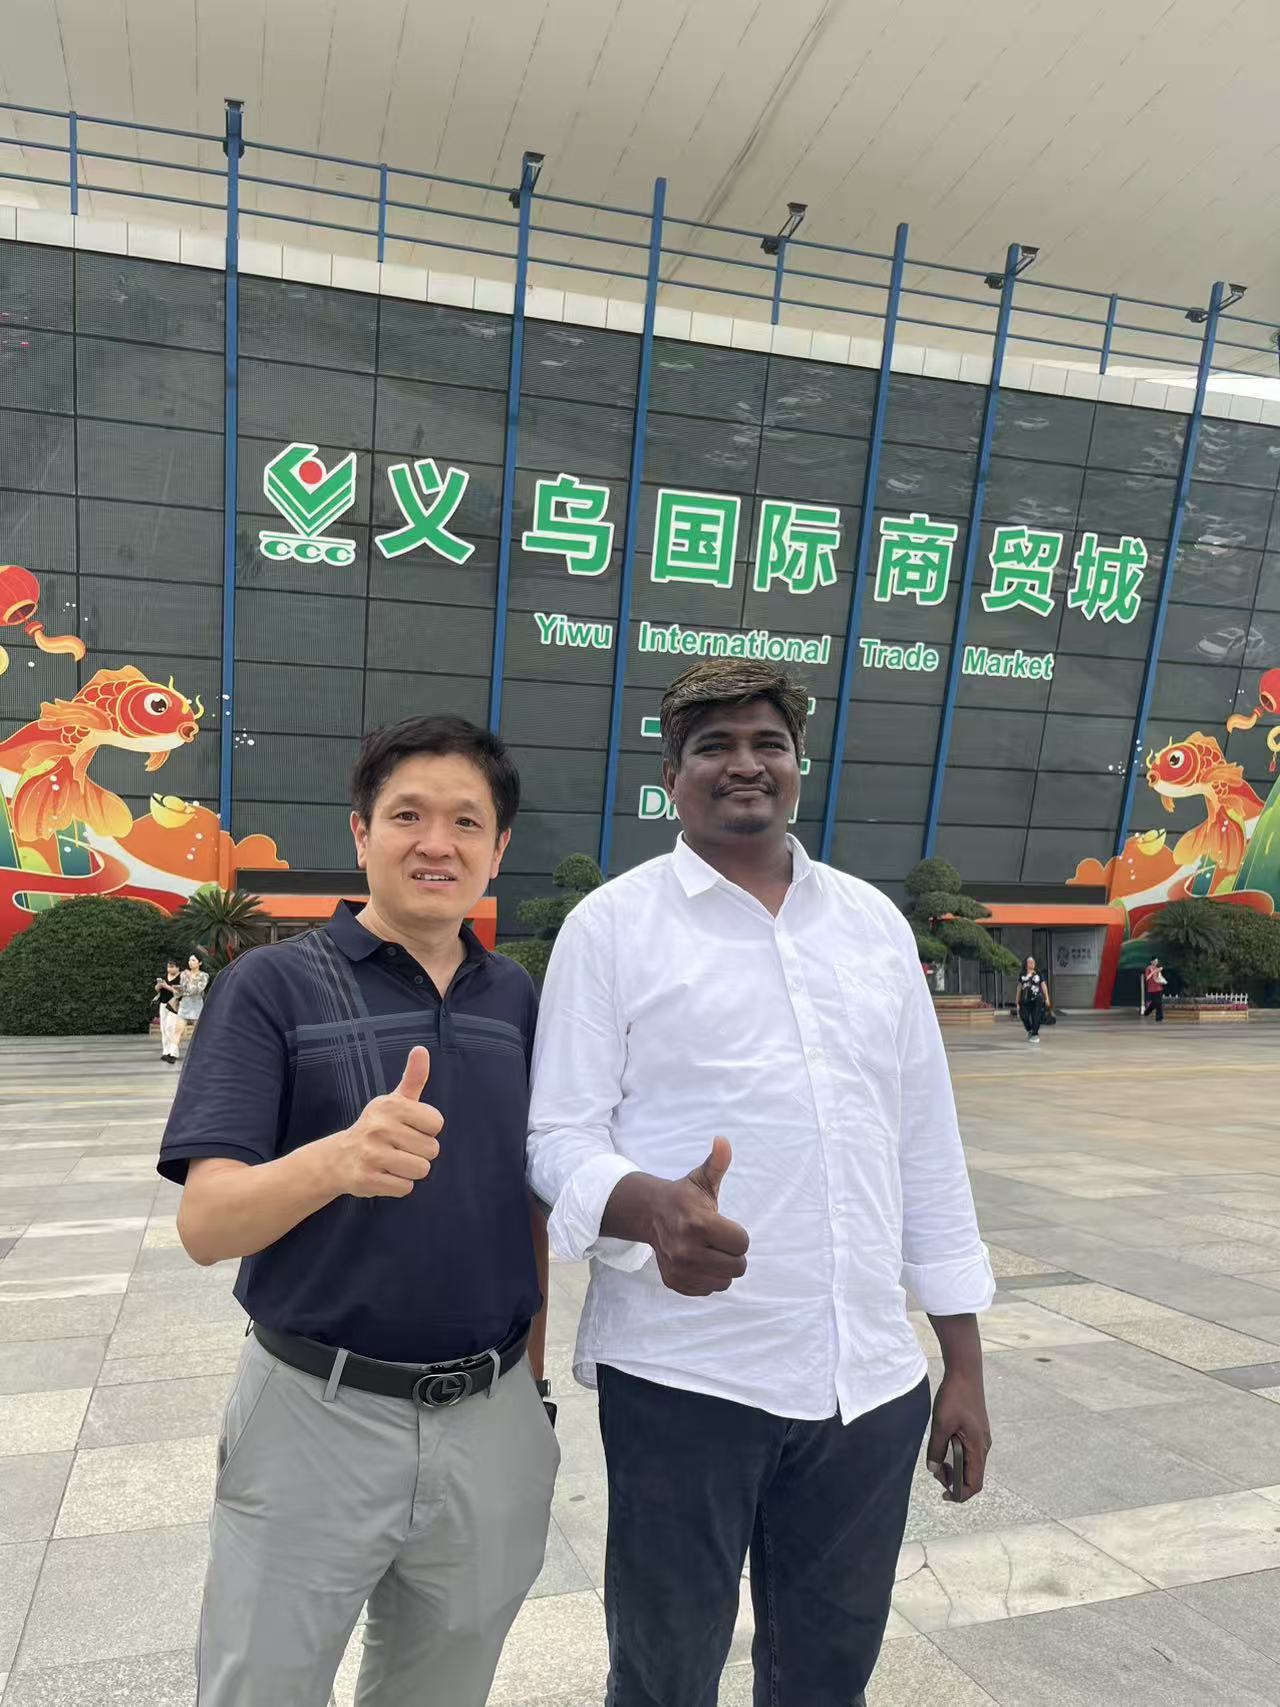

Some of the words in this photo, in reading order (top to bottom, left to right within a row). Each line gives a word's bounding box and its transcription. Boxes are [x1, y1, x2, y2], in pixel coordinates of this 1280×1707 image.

[375, 458, 1148, 624] 义乌国际商贸城
[534, 612, 613, 650] Yiwu
[638, 621, 832, 665] International
[859, 638, 939, 672] Trade
[962, 647, 1054, 681] Market
